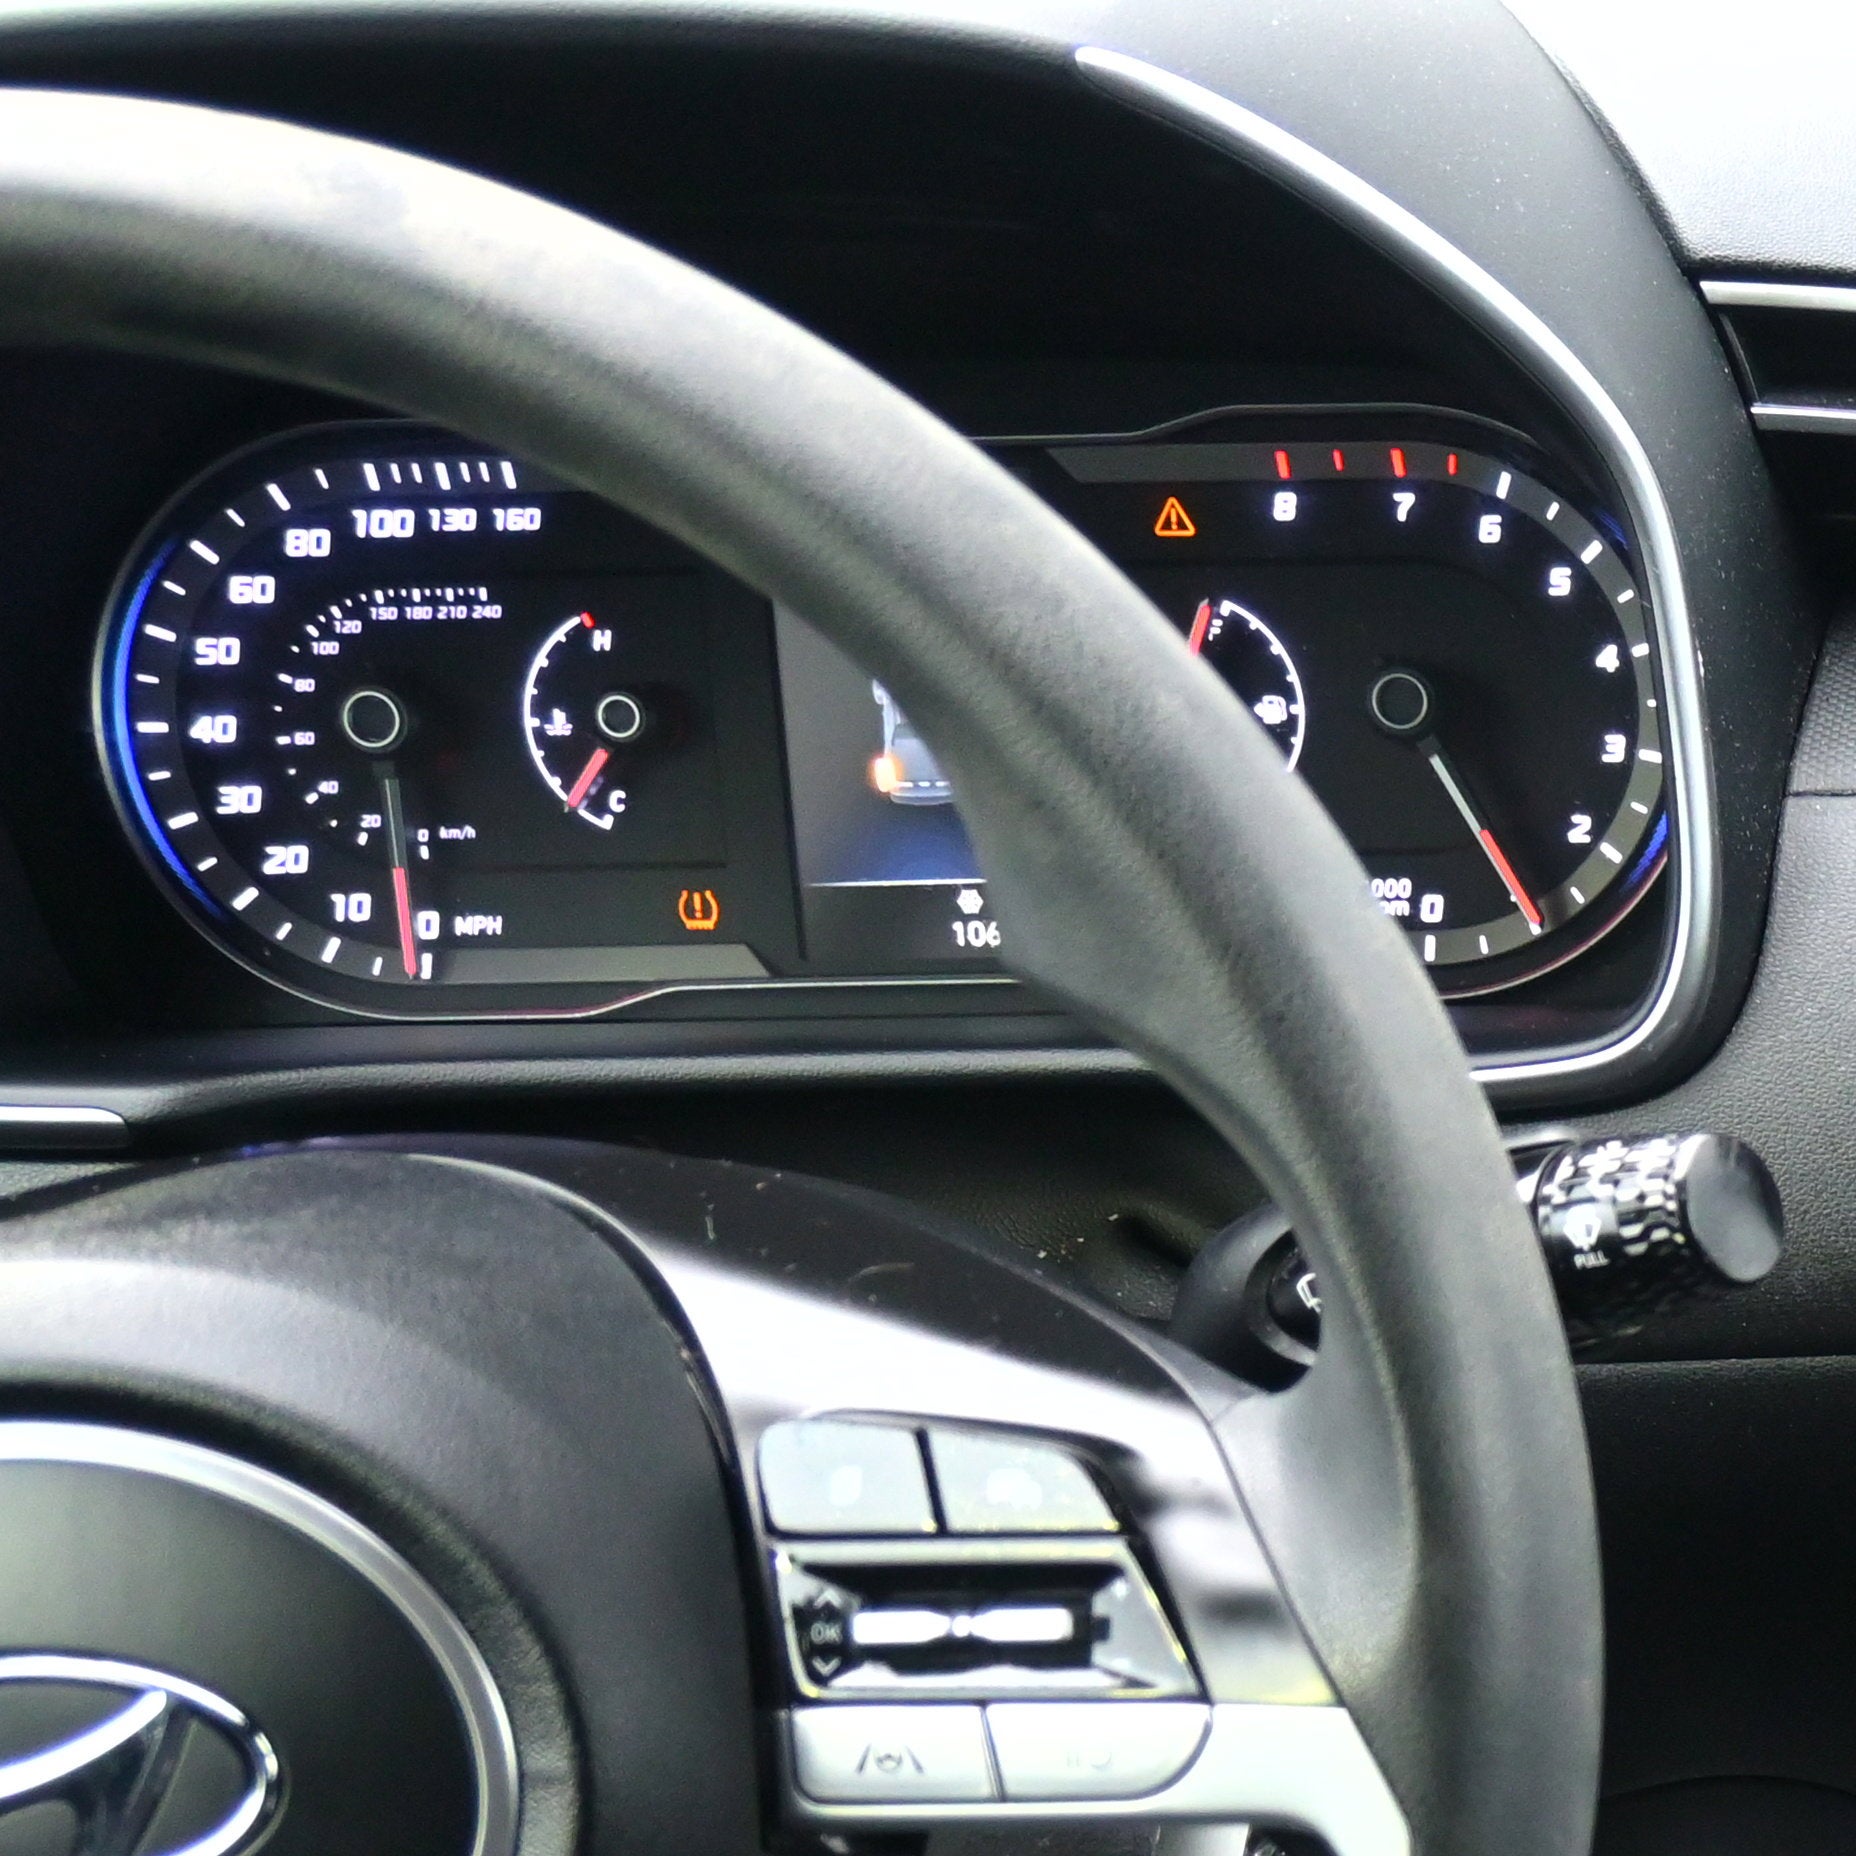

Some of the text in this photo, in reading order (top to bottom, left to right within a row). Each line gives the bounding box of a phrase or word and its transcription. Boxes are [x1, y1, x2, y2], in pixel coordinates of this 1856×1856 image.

[1272, 492, 1297, 522] 8
[1393, 493, 1415, 522] 7
[353, 509, 414, 538] 100
[429, 508, 477, 532] 130
[493, 508, 542, 532] 160
[1478, 515, 1502, 544] 6
[285, 529, 331, 556] 80
[229, 576, 275, 604] 60
[1548, 568, 1572, 596] 5
[370, 607, 398, 620] 150
[405, 607, 432, 620] 180
[437, 606, 467, 619] 210
[472, 605, 502, 619] 240
[334, 620, 362, 634] 120
[194, 637, 241, 666] 50
[311, 641, 339, 655] 100
[592, 630, 611, 651] H
[1595, 644, 1619, 673] 4
[294, 678, 315, 692] 80
[189, 715, 237, 744] 40
[294, 732, 315, 745] 60
[1603, 735, 1626, 763] 3
[216, 785, 262, 813] 30
[318, 781, 339, 794] 40
[609, 791, 626, 812] C
[361, 815, 381, 827] 20
[440, 826, 476, 839] km/h
[1567, 815, 1592, 843] 2
[418, 829, 429, 842] 0
[263, 846, 310, 874] 20
[1365, 877, 1412, 899] 000
[330, 894, 371, 921] 10
[1420, 893, 1444, 923] 0
[417, 911, 440, 941] 0
[455, 916, 502, 936] MPH
[810, 1622, 843, 1645] OK
